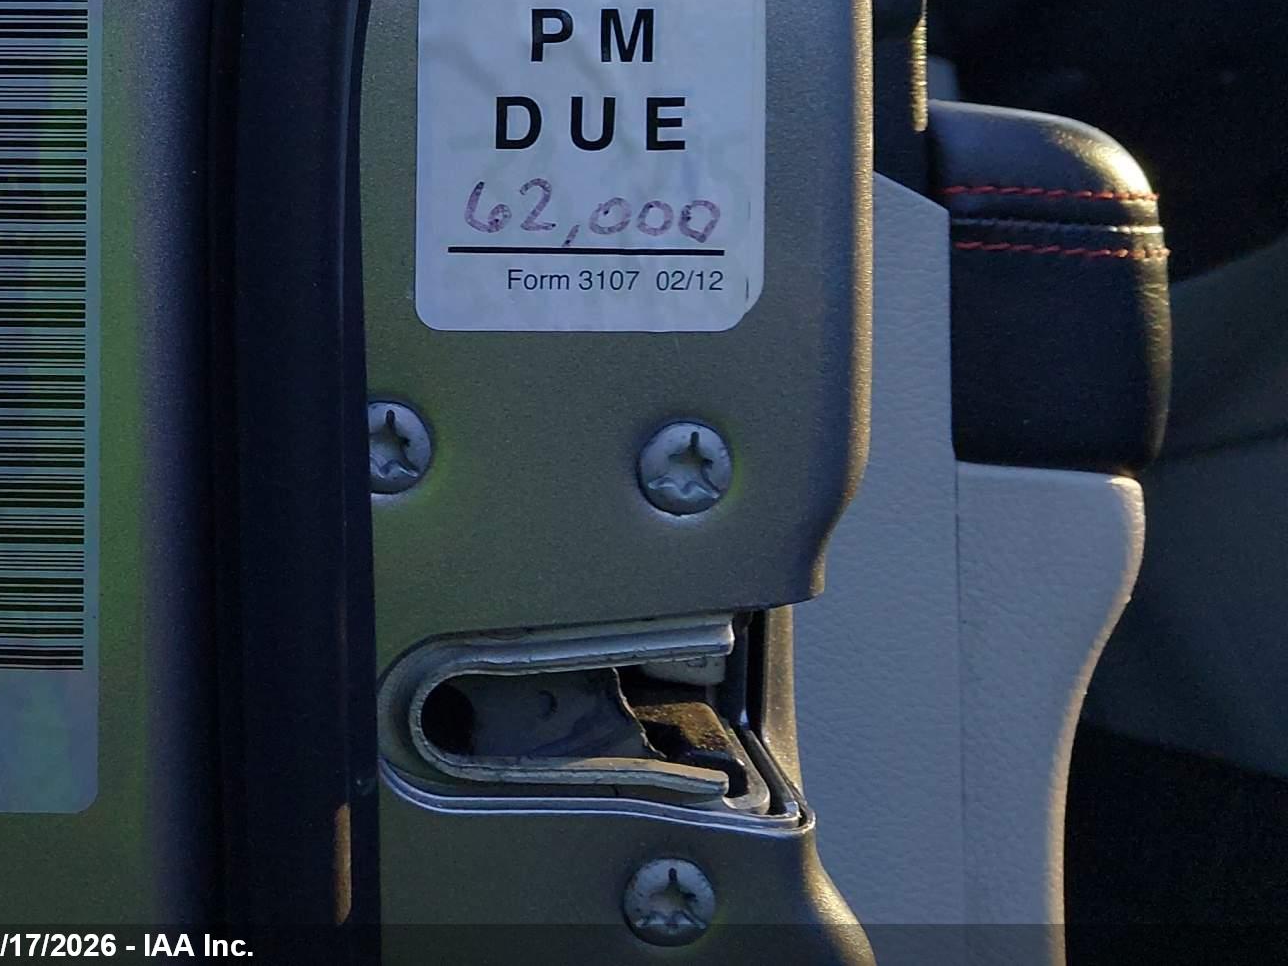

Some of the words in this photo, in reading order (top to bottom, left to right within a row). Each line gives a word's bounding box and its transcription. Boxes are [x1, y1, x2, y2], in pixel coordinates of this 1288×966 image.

[531, 9, 654, 62] PM
[495, 96, 686, 151] DUE
[464, 178, 721, 247] 62,000
[508, 270, 569, 290] Form
[579, 271, 639, 290] 3107
[656, 271, 723, 291] 02/12
